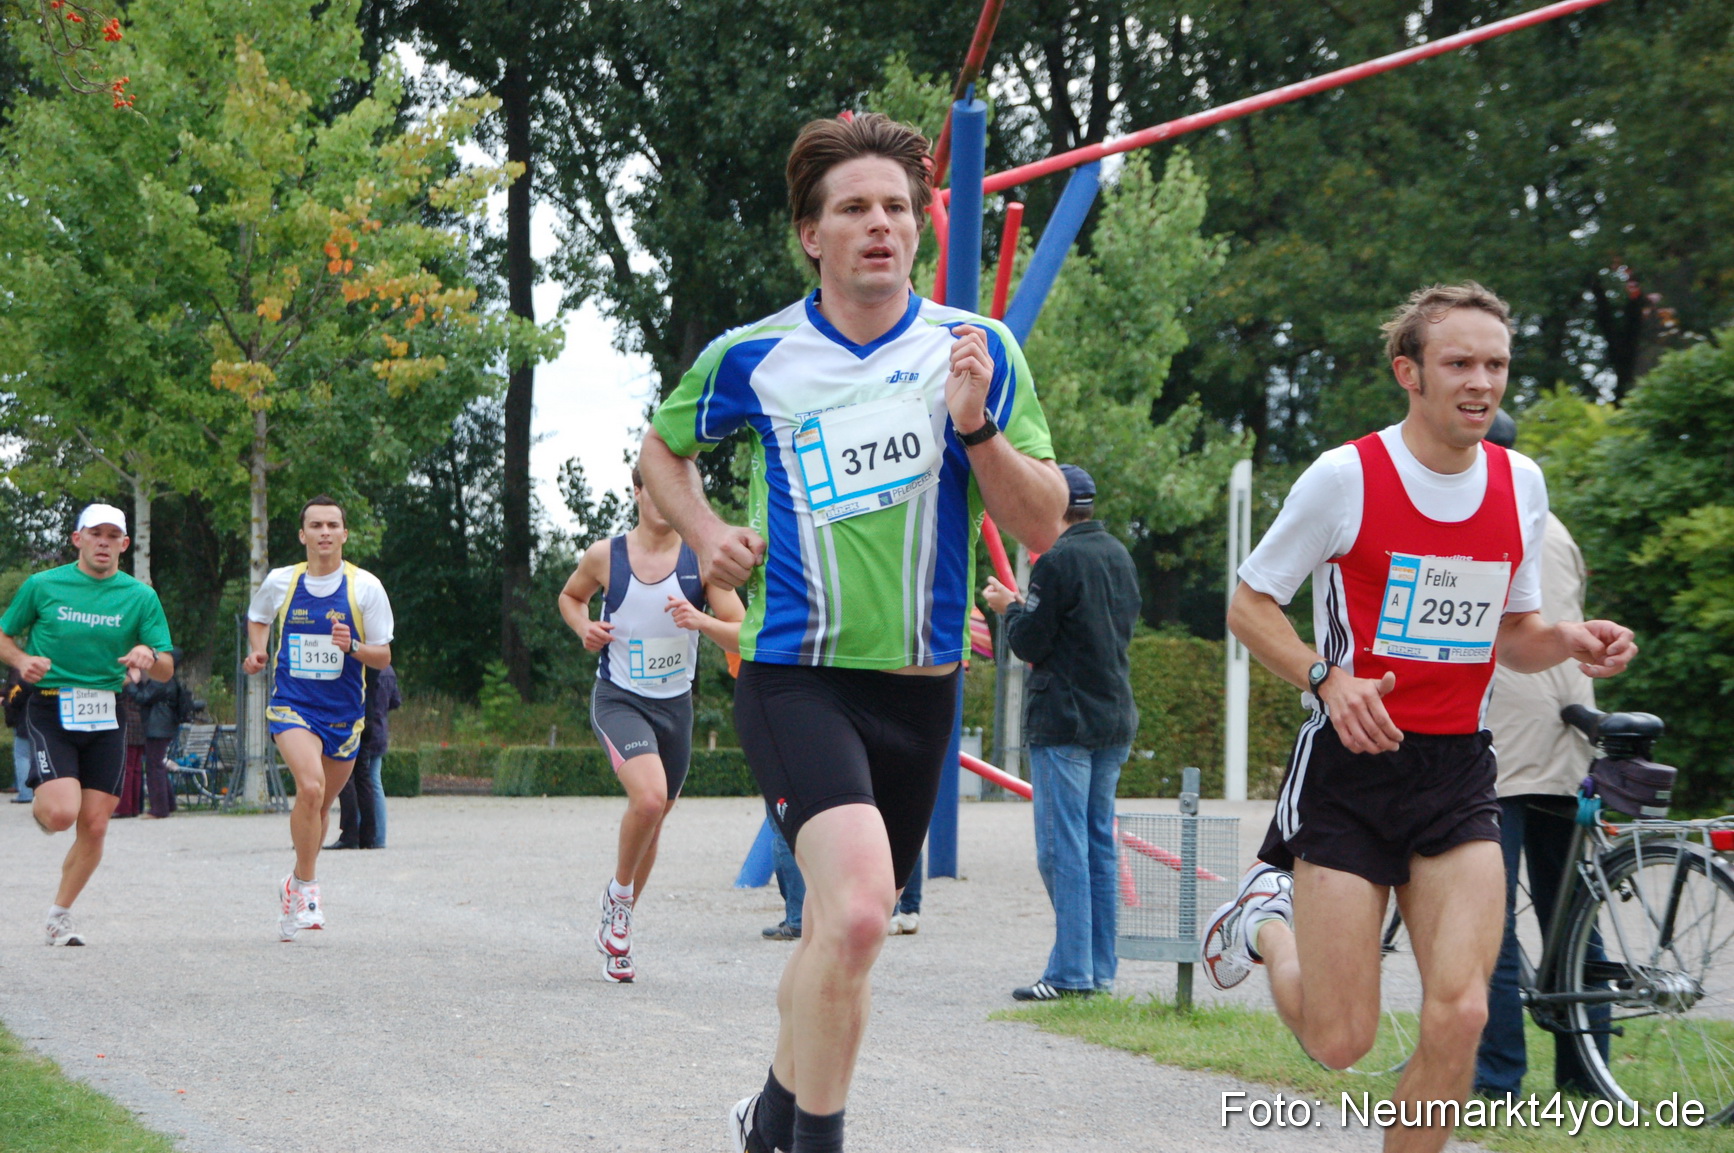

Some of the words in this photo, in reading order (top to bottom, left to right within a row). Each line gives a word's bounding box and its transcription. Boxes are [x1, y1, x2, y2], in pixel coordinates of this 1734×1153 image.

[842, 432, 921, 476] 3740
[1424, 568, 1458, 587] Felix
[1391, 593, 1399, 606] A
[57, 606, 122, 628] Sinupret
[1419, 598, 1490, 627] 2937
[305, 652, 338, 664] 3136
[648, 653, 682, 670] 2202
[76, 690, 98, 699] Stefan
[77, 703, 108, 715] 2311
[624, 740, 649, 751] ODLO
